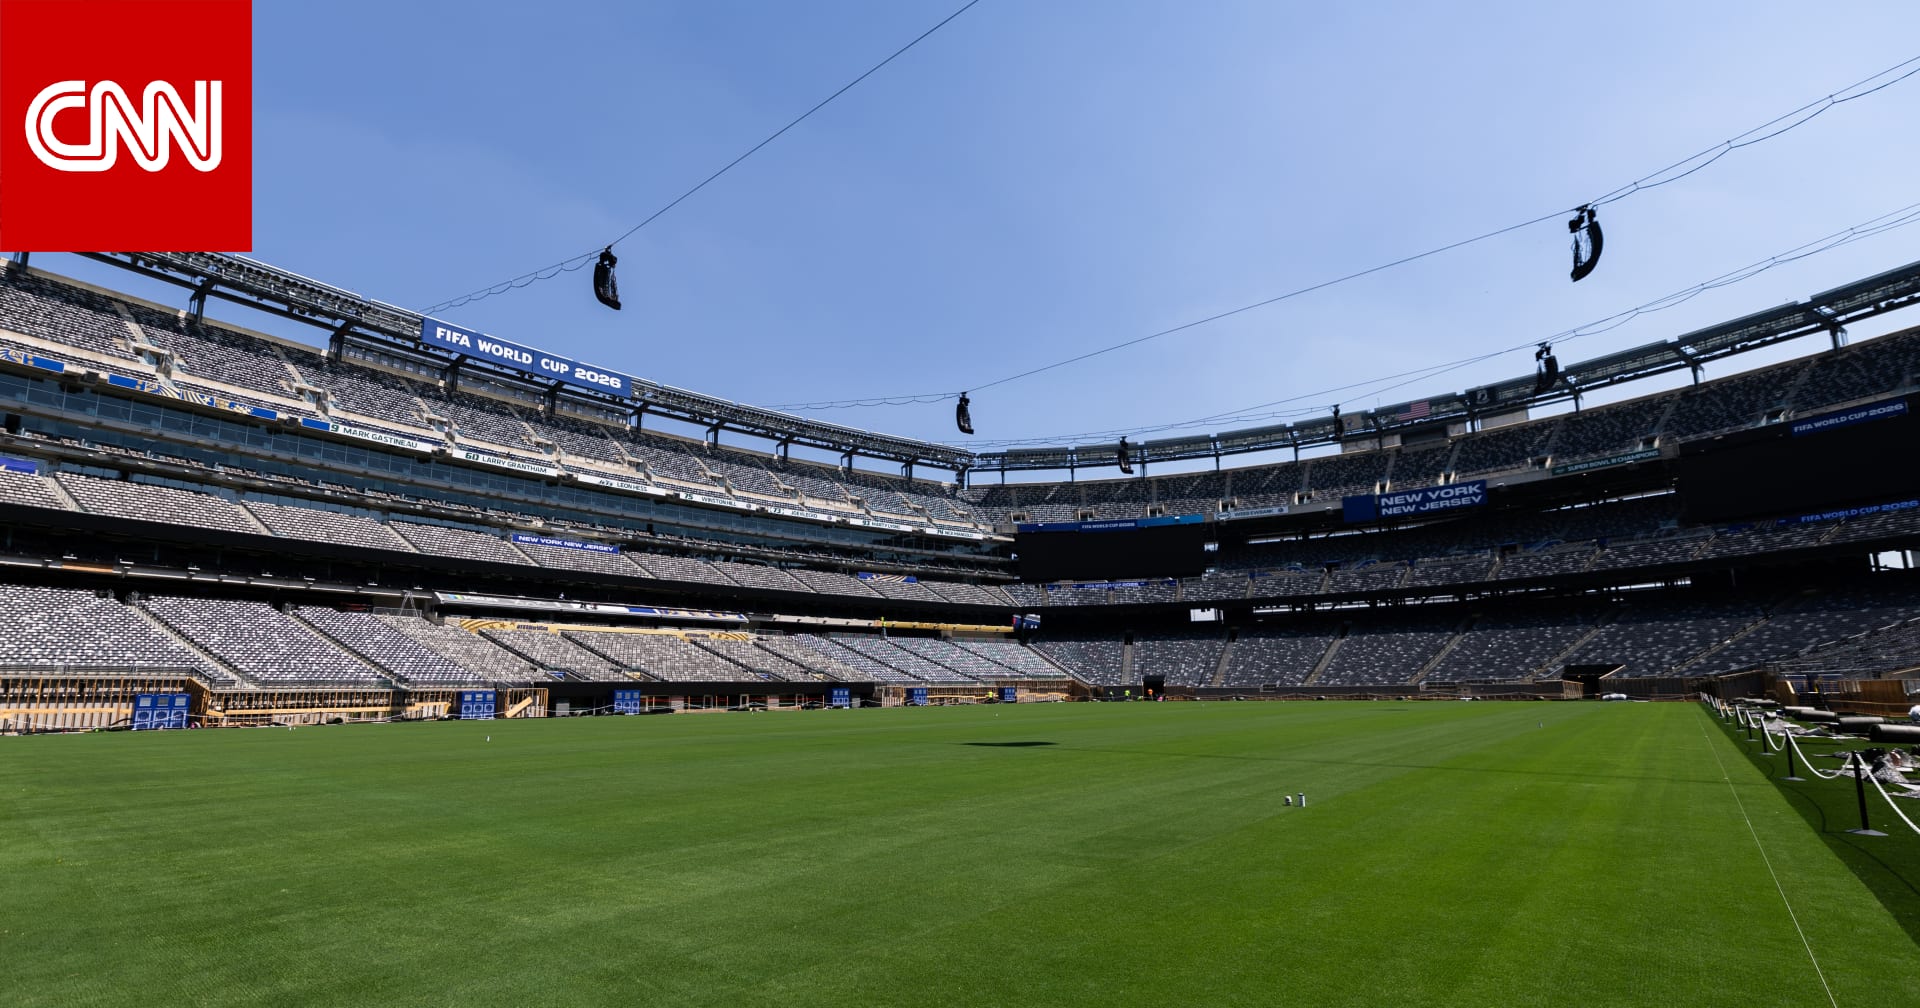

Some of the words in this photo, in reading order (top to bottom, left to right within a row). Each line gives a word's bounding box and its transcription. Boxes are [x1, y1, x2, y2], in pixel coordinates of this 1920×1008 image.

[436, 327, 471, 348] FIFA
[478, 339, 533, 364] WORLD
[540, 357, 569, 374] CUP
[574, 367, 622, 389] 2026
[1794, 422, 1814, 433] FIFA
[1814, 416, 1847, 429] WORLD
[1847, 411, 1868, 421] CUP
[1868, 403, 1905, 416] 2026
[343, 427, 370, 439] MARK
[371, 433, 418, 449] GASTINEAU
[464, 452, 480, 461] 60
[482, 456, 506, 467] LARRY
[507, 461, 548, 474] GRANTHAM
[1567, 462, 1589, 472] SUPER
[1589, 459, 1611, 469] BOWL
[1617, 450, 1660, 464] CHAMPIONS
[1380, 493, 1423, 507] NEW
[1427, 484, 1482, 500] YORK
[1381, 505, 1417, 516] NEW
[1419, 495, 1483, 512] JERSEY
[1801, 515, 1821, 523] FIFA
[1822, 509, 1858, 520] WORLD
[1859, 505, 1880, 515] CUP
[1881, 500, 1919, 512] 2026
[540, 538, 563, 546] YORK
[583, 544, 614, 552] JERSEY
